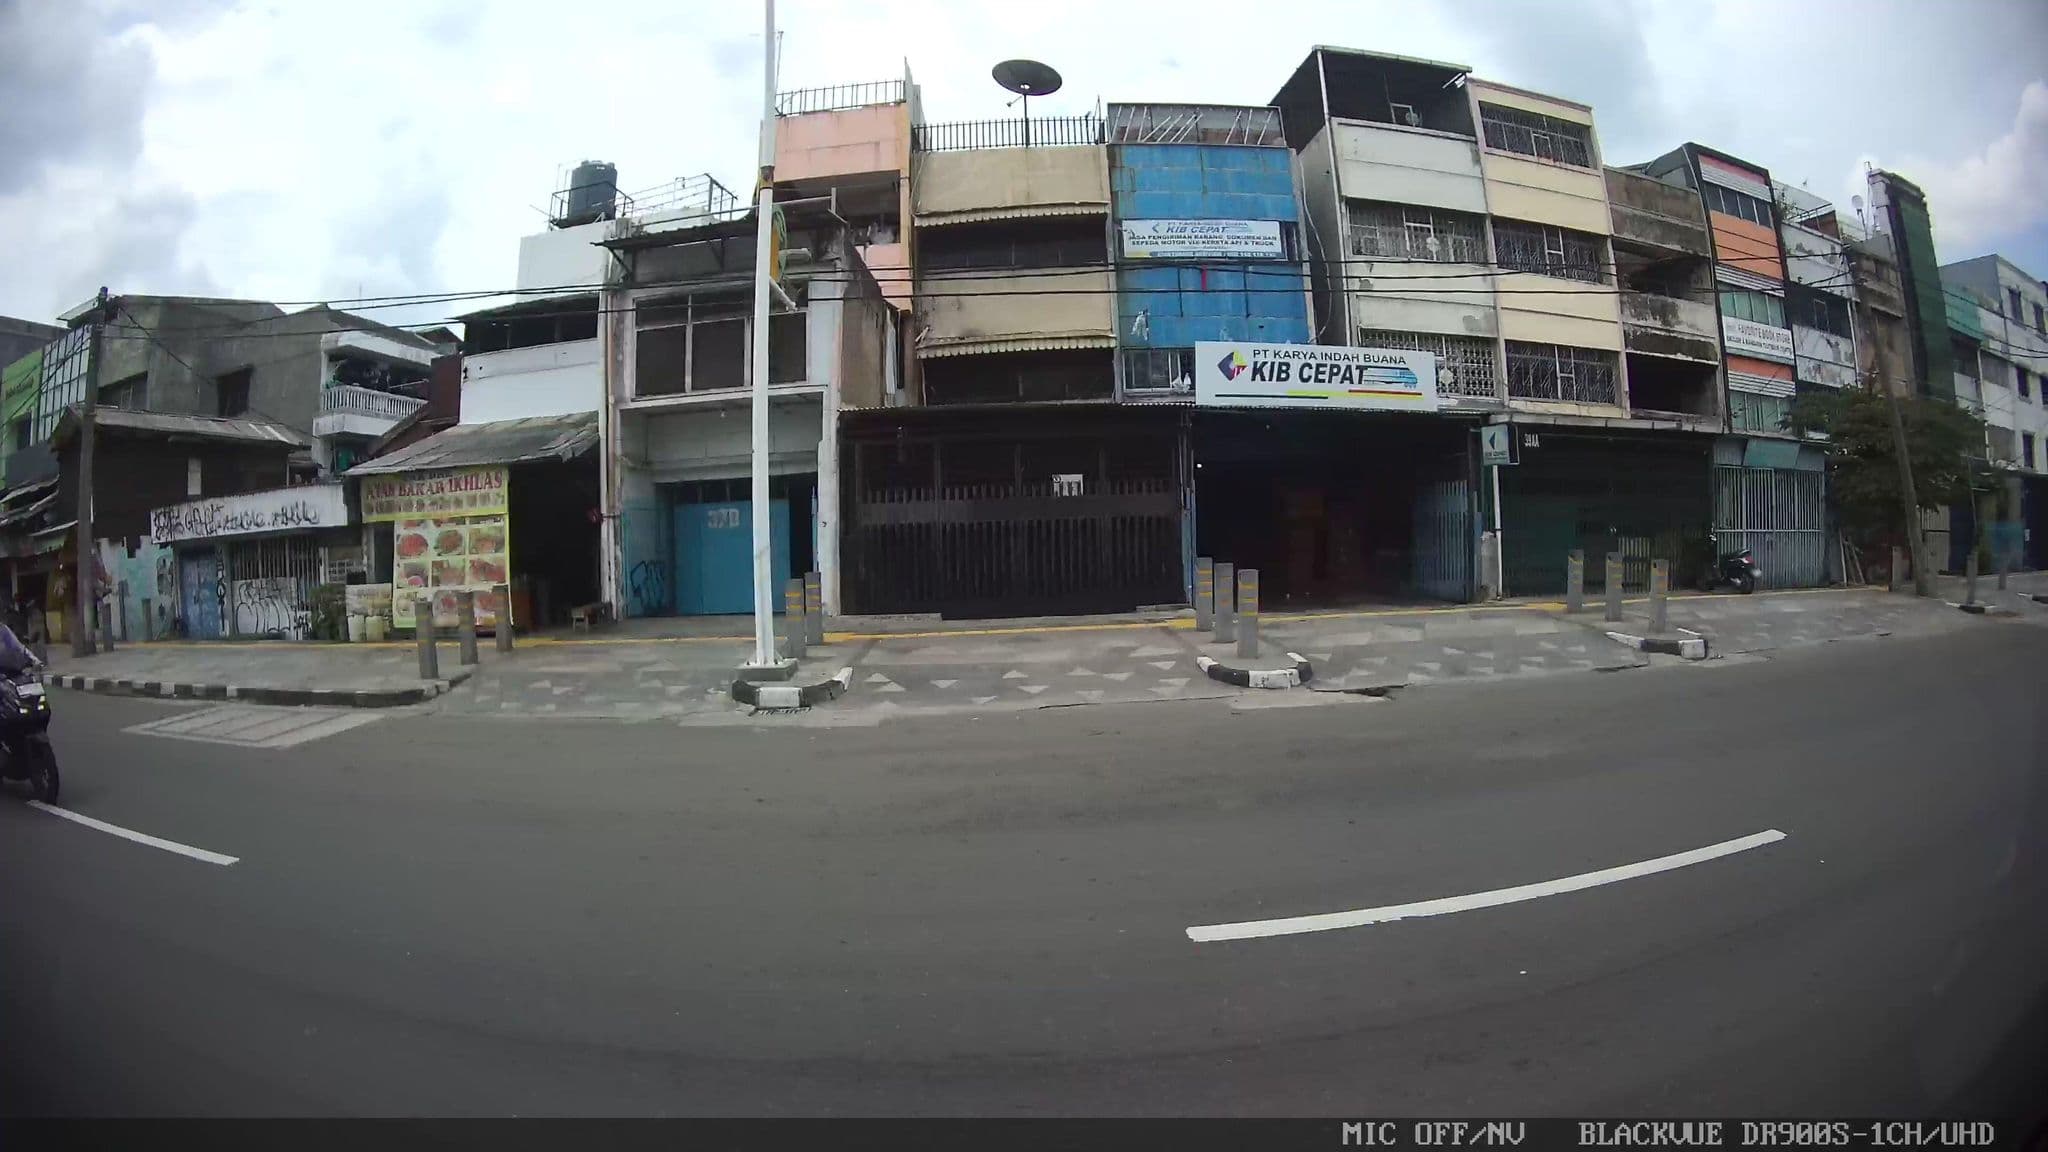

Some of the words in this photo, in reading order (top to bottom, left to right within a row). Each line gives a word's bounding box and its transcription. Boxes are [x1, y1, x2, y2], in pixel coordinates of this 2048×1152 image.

[1253, 350, 1268, 358] PT
[1274, 350, 1316, 360] KARYA
[1320, 352, 1359, 362] INDAH
[1364, 353, 1406, 365] BUANA
[1251, 361, 1291, 382] KIB
[1299, 362, 1368, 385] CEPAT
[399, 481, 445, 497] BAKAR
[448, 472, 503, 492] IKHLAS
